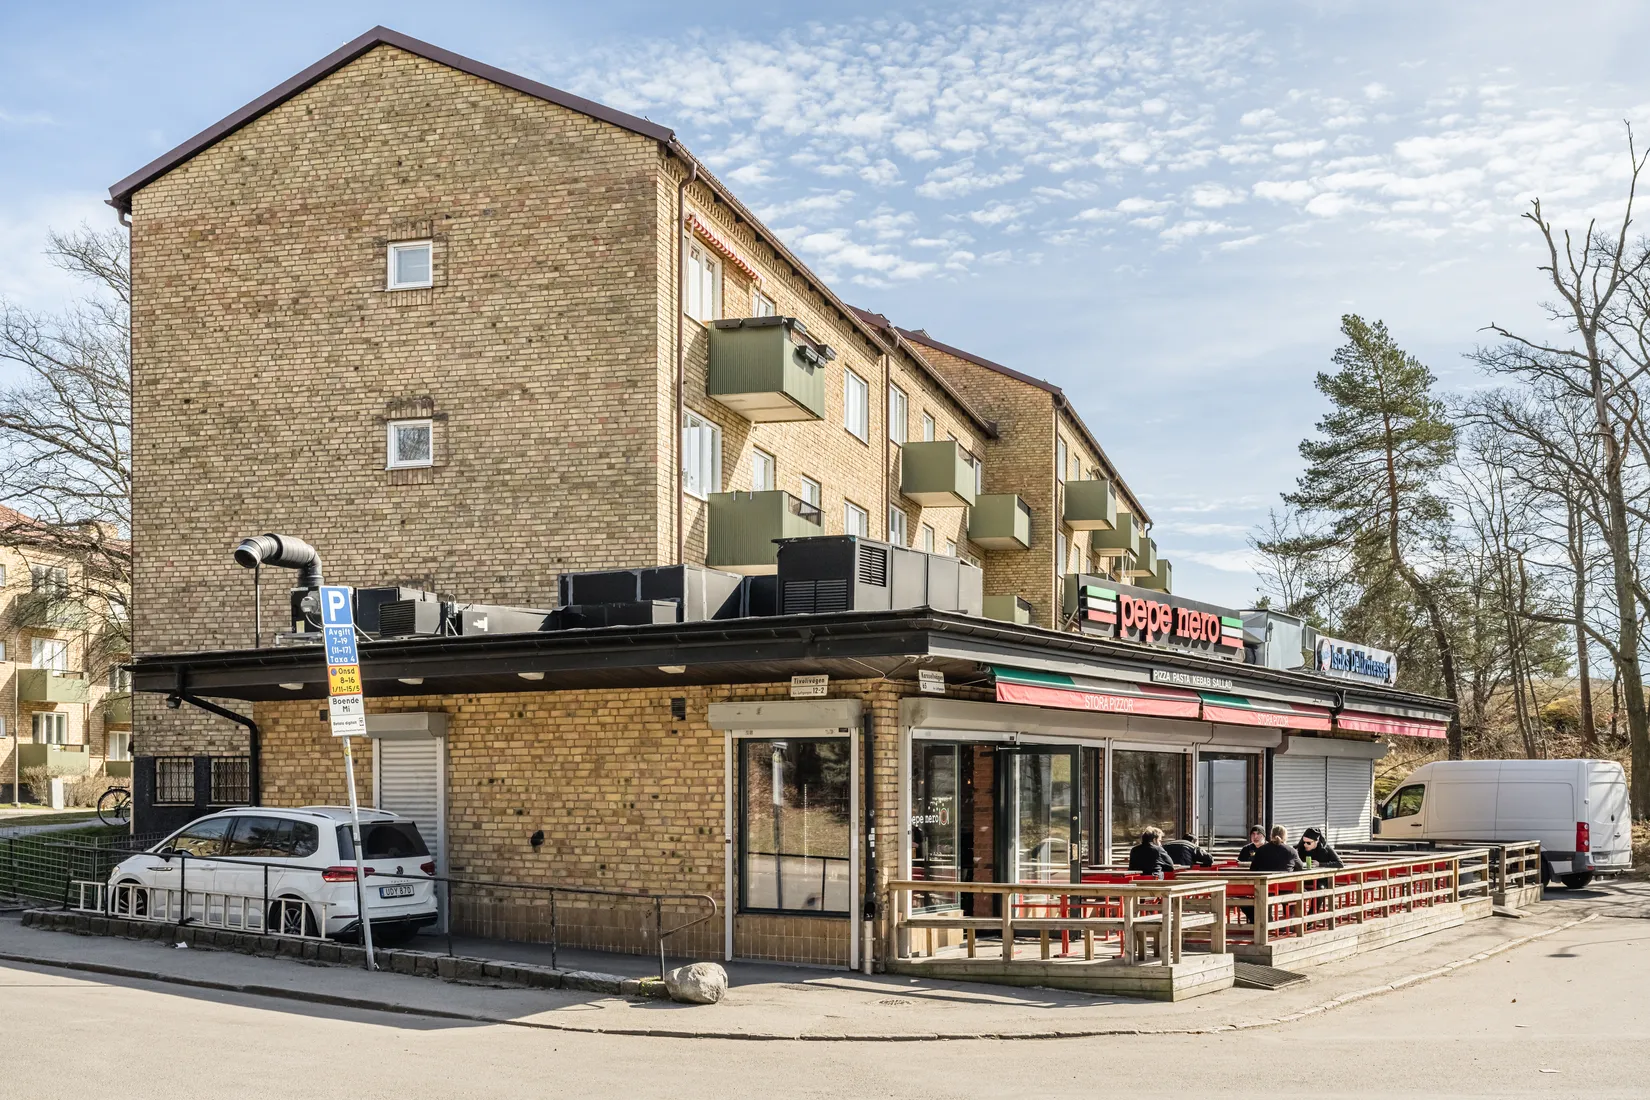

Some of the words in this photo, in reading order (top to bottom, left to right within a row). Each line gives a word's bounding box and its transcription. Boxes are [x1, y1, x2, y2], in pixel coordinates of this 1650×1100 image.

[328, 591, 345, 621] P
[1119, 594, 1173, 643] pepe
[1176, 607, 1220, 644] nero
[328, 627, 351, 638] Avgift
[331, 645, 352, 654] (11-17)
[350, 655, 356, 663] 4
[338, 667, 355, 675] Onsd
[793, 677, 825, 685] Tivolivägen
[1153, 669, 1171, 682] PIZZA
[1172, 672, 1191, 685] PASTA
[1192, 675, 1211, 687] KEBAB
[1212, 678, 1233, 690] SALLAD
[332, 697, 360, 705] Boende
[1084, 694, 1110, 710] STORA
[1109, 697, 1134, 712] PIZZOR
[342, 705, 351, 713] Mi
